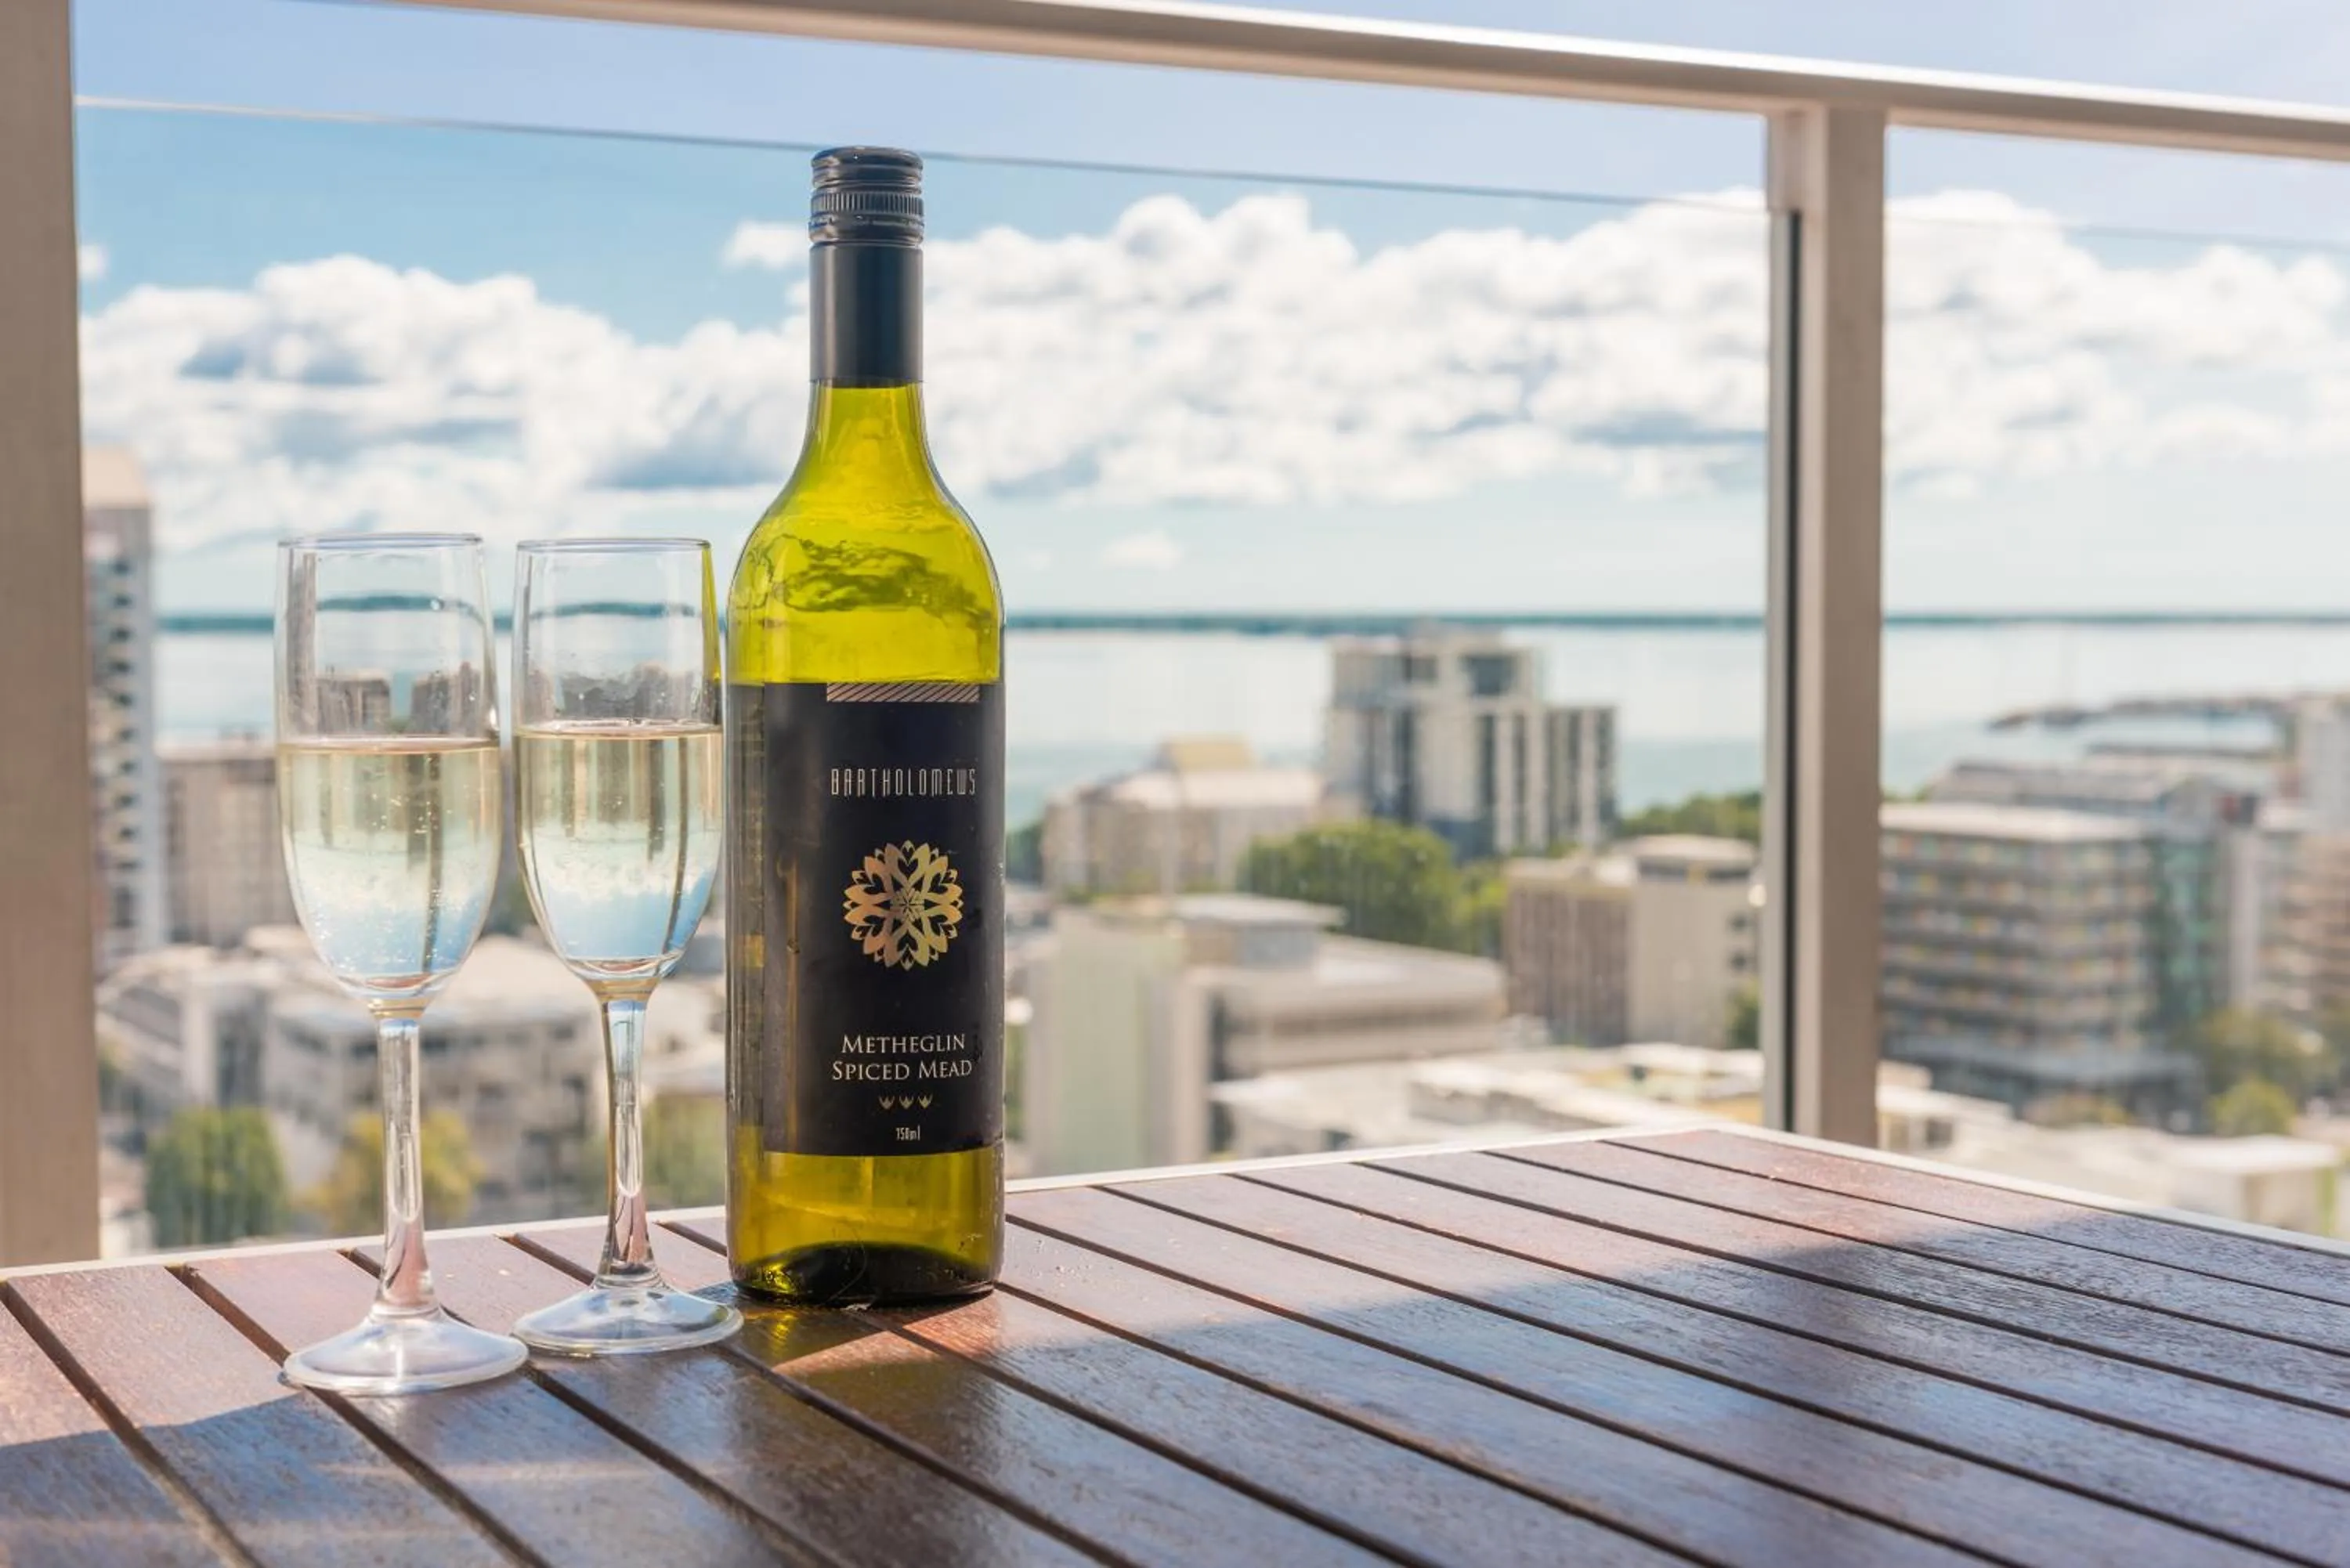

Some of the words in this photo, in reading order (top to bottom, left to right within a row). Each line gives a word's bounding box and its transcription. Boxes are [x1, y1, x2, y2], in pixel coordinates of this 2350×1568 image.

[831, 768, 976, 797] BARTHOLOMEWS
[841, 1033, 966, 1054] METHEGLIN
[832, 1060, 910, 1081] SPICED
[918, 1059, 973, 1079] MEAD
